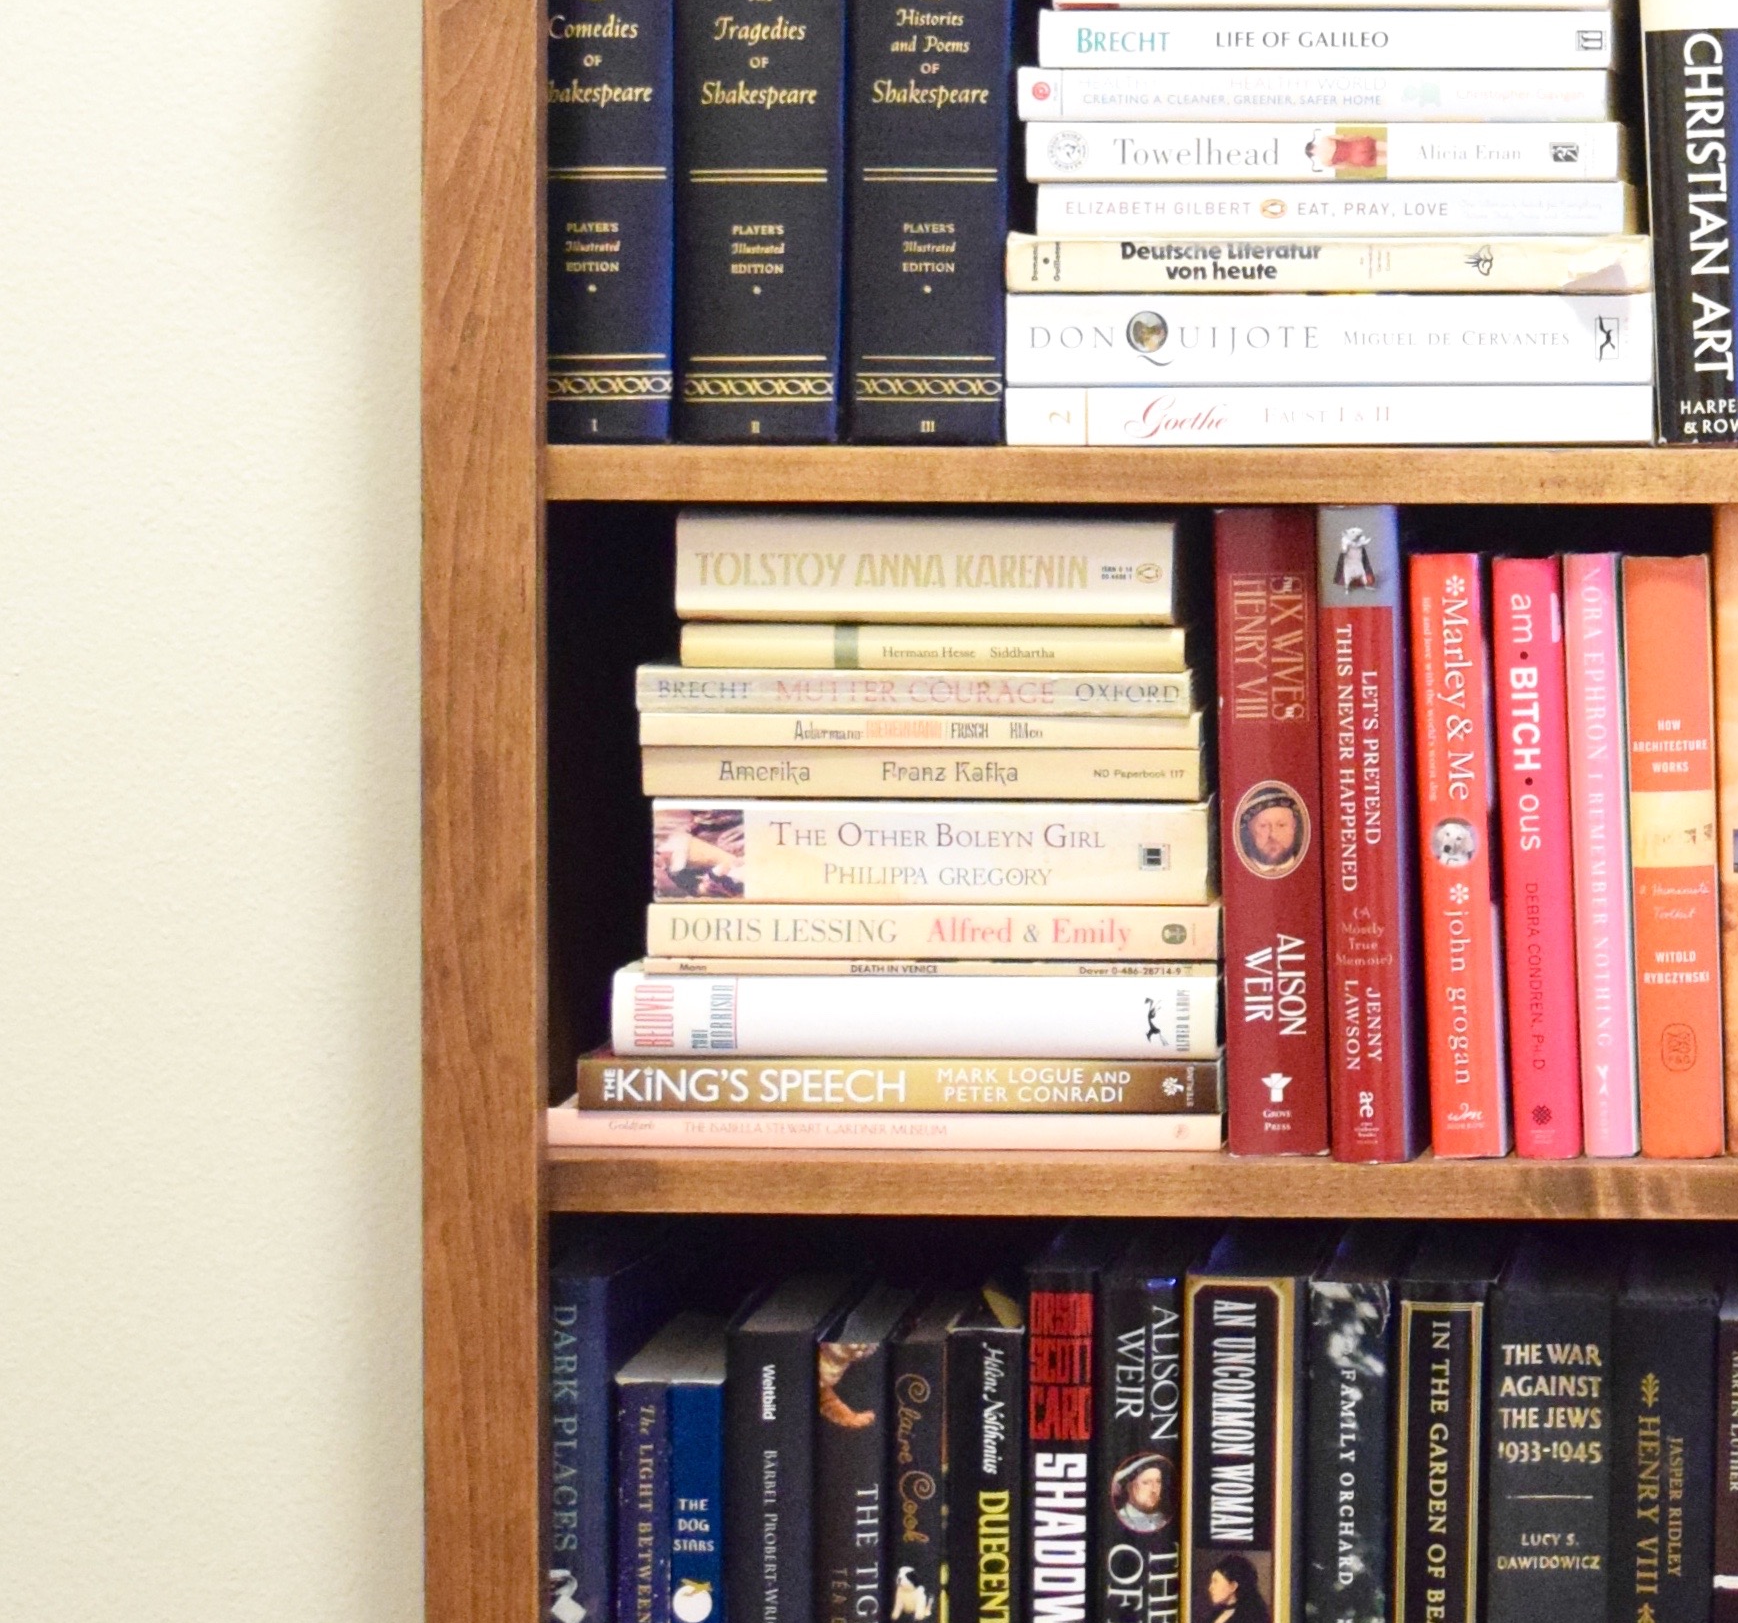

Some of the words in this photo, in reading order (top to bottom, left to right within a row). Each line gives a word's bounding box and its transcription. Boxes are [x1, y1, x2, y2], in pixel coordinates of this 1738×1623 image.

[714, 16, 806, 46] Tragedies
[1076, 27, 1171, 53] BRECHT
[1216, 30, 1256, 49] LIFE
[1262, 30, 1292, 49] OF
[1298, 30, 1389, 48] GALILEO
[749, 56, 769, 69] OF
[701, 81, 817, 110] Shakespeare
[1683, 33, 1730, 275] CHRISTIAN
[1692, 292, 1734, 381] ART
[1685, 420, 1696, 433] &
[770, 822, 828, 848] THE
[837, 823, 928, 849] OTHER
[935, 822, 1033, 849] BOLEYN
[1044, 823, 1105, 849] GIRL
[824, 863, 928, 886] PHILIPPA
[939, 866, 1052, 887] GREGORY
[603, 1069, 615, 1102] THE
[760, 1069, 905, 1103] SPEECH
[937, 1068, 997, 1084] MARK
[1008, 1068, 1085, 1085] LOGUE
[1092, 1070, 1130, 1084] AND
[944, 1086, 1008, 1102] PETER
[1018, 1086, 1123, 1103] CONRADI
[1213, 1299, 1257, 1328] AN
[1502, 1345, 1543, 1365] THE
[1548, 1345, 1602, 1365] WAR
[1114, 1329, 1145, 1419] WEIR
[1149, 1305, 1179, 1441] ALISON
[1500, 1376, 1601, 1396] AGAINST
[1211, 1335, 1257, 1456] UNCOMMON
[1500, 1408, 1539, 1427] THE
[1542, 1408, 1601, 1428] JEWS
[1210, 1462, 1255, 1541] WOMAN
[1106, 1543, 1145, 1609] OF
